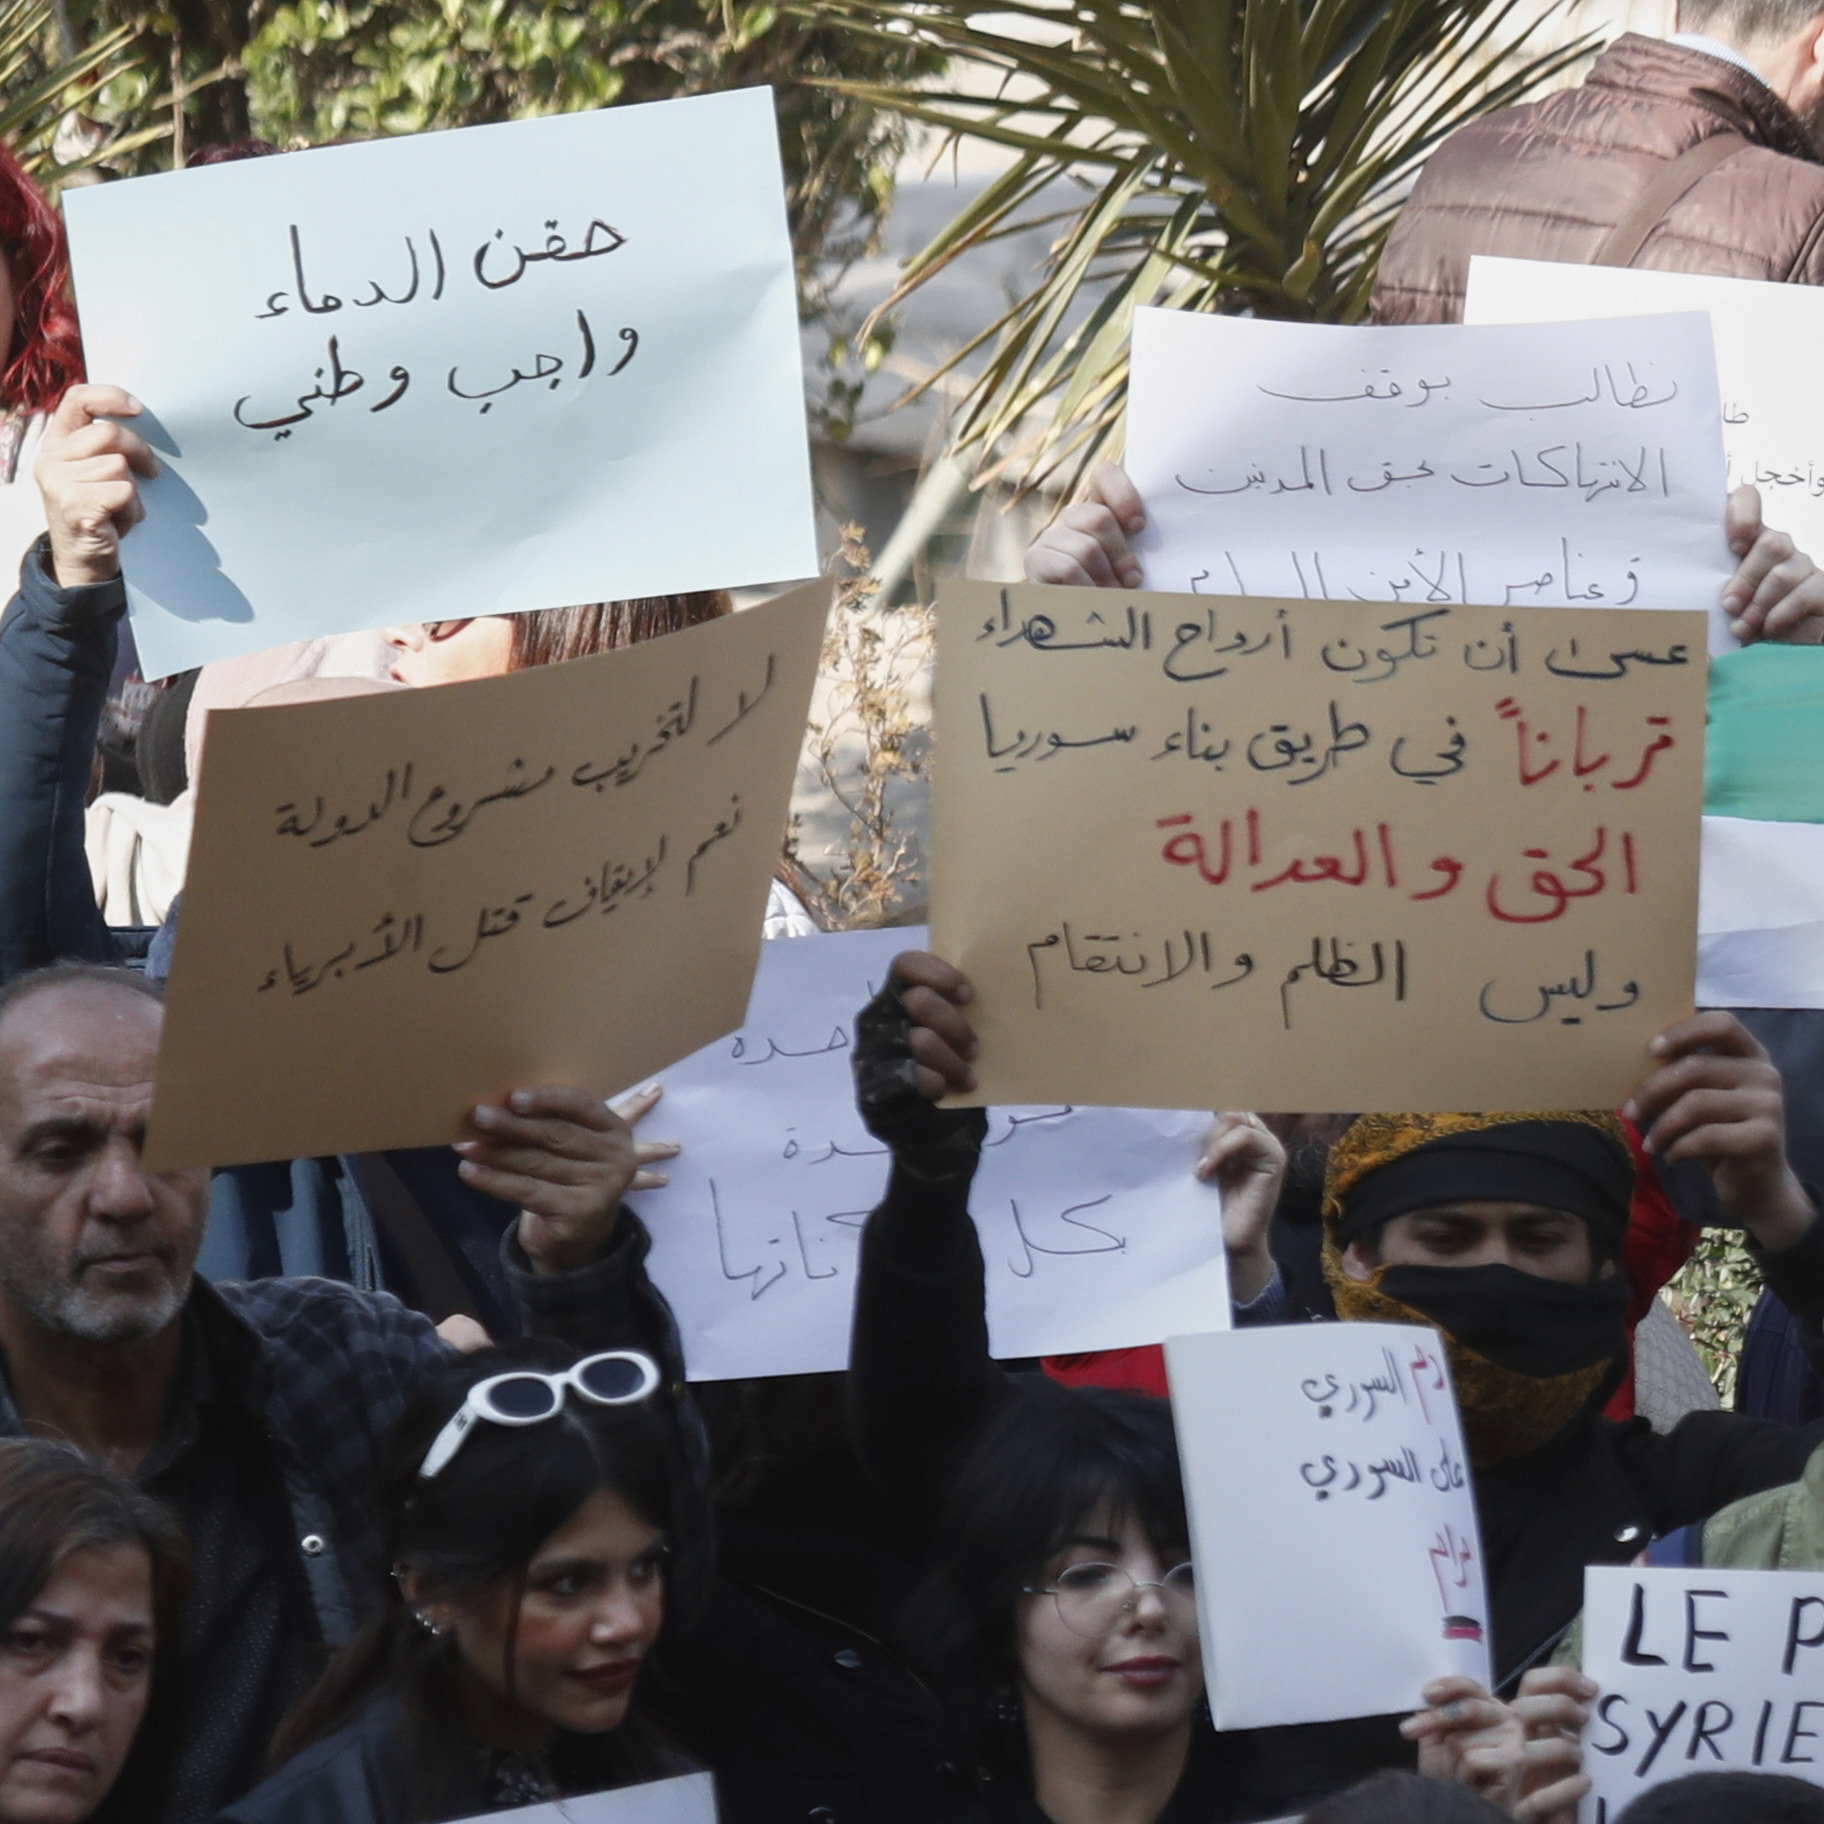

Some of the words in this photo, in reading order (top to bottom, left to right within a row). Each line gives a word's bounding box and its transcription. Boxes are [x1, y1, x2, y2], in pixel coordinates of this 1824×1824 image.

[255, 224, 445, 319] الدماء
[475, 217, 628, 289] حقن
[233, 335, 411, 441] وطني
[449, 309, 639, 414] واجب
[1478, 360, 1677, 423] نطالب
[1452, 444, 1668, 503] الانتهاكات
[975, 590, 1152, 652] الشهداء
[1164, 608, 1292, 680] أرواح
[1322, 608, 1451, 683] تكون
[1463, 622, 1519, 674] أن
[708, 654, 774, 746] لا
[978, 693, 1136, 772] سوريا
[1151, 707, 1231, 772] بناء
[1247, 701, 1369, 784] طريق
[1390, 716, 1466, 785] في
[276, 762, 412, 847] الدولة
[408, 759, 553, 847] مشروع
[686, 795, 740, 896] نعم
[1486, 825, 1638, 923] الحق
[257, 914, 424, 996] الأبرياء
[428, 895, 534, 973] قتل
[1280, 936, 1407, 1029] الظلم
[1479, 950, 1639, 1025] وليس
[1008, 1195, 1127, 1278] بكل
[1301, 1346, 1407, 1422] السوري
[1300, 1446, 1421, 1501] السوري
[1621, 1583, 1731, 1674] LE
